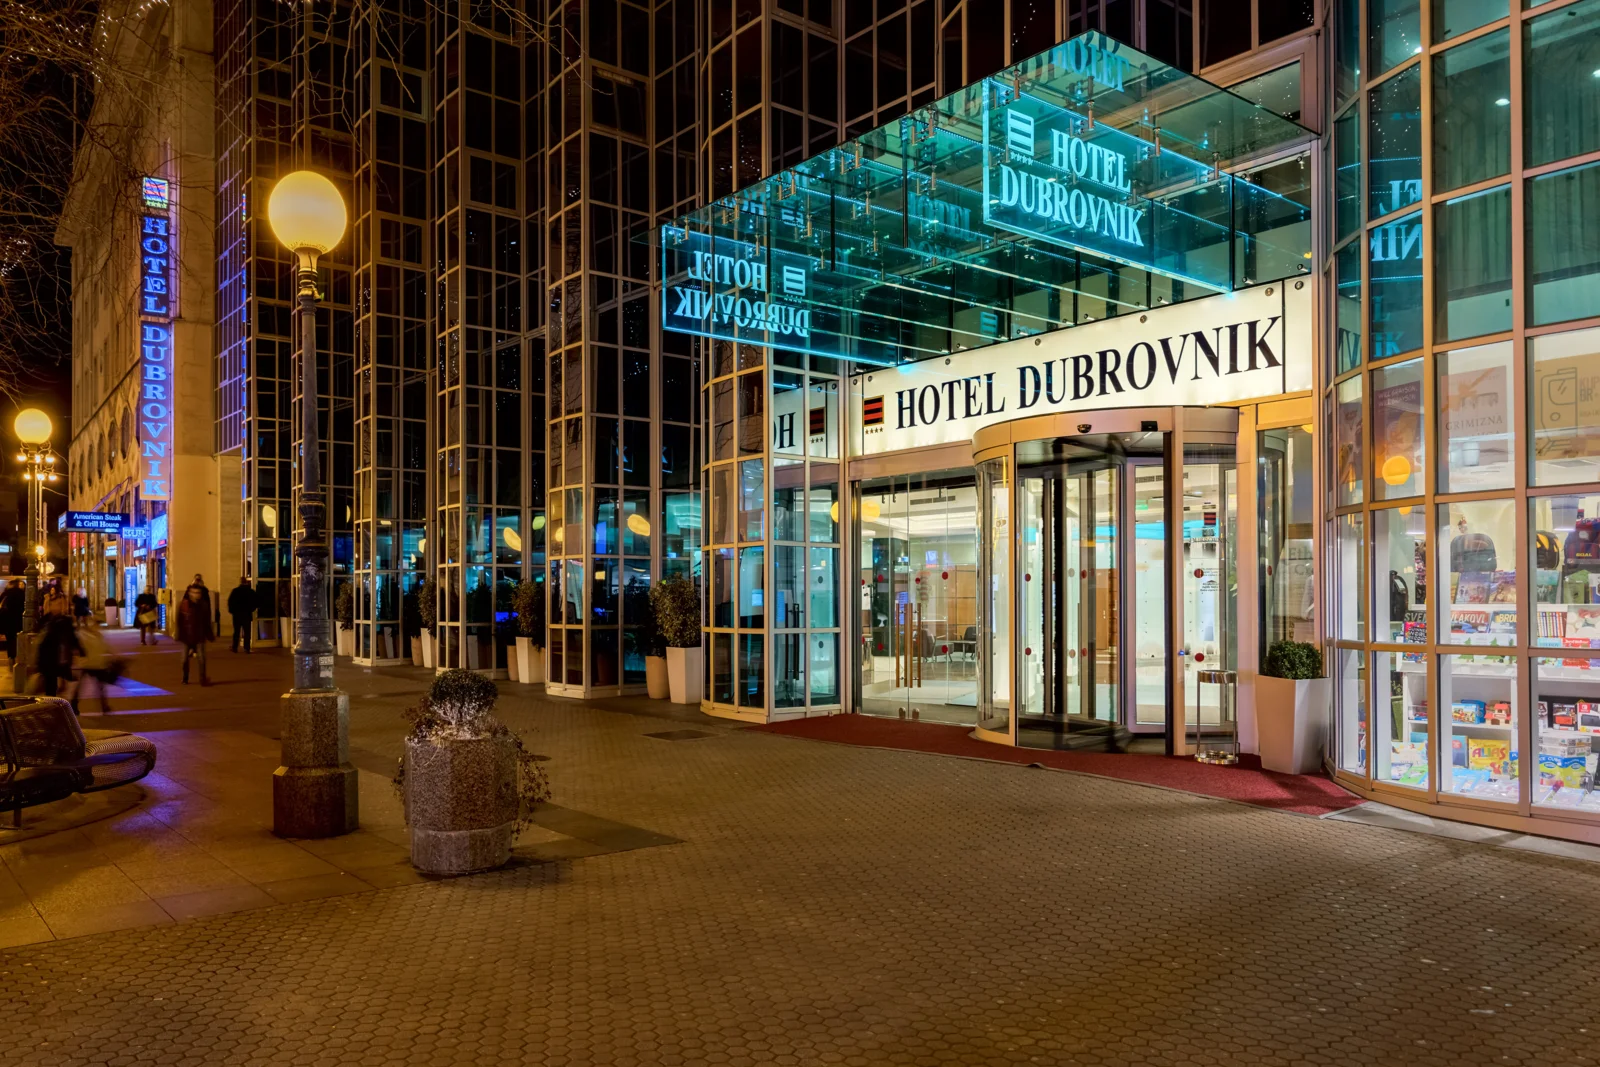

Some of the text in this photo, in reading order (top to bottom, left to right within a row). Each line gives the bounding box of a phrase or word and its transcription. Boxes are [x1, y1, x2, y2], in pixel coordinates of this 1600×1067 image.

[1051, 128, 1131, 192] HOTEL
[1000, 164, 1144, 247] DUBROVNIK
[143, 216, 168, 313] HOTEL
[143, 325, 168, 496] DUBROVNIK
[895, 315, 1282, 430] HOTEL DUBROVNIK
[1445, 415, 1503, 431] GRIMIZNA
[1472, 747, 1507, 761] ALIAS
